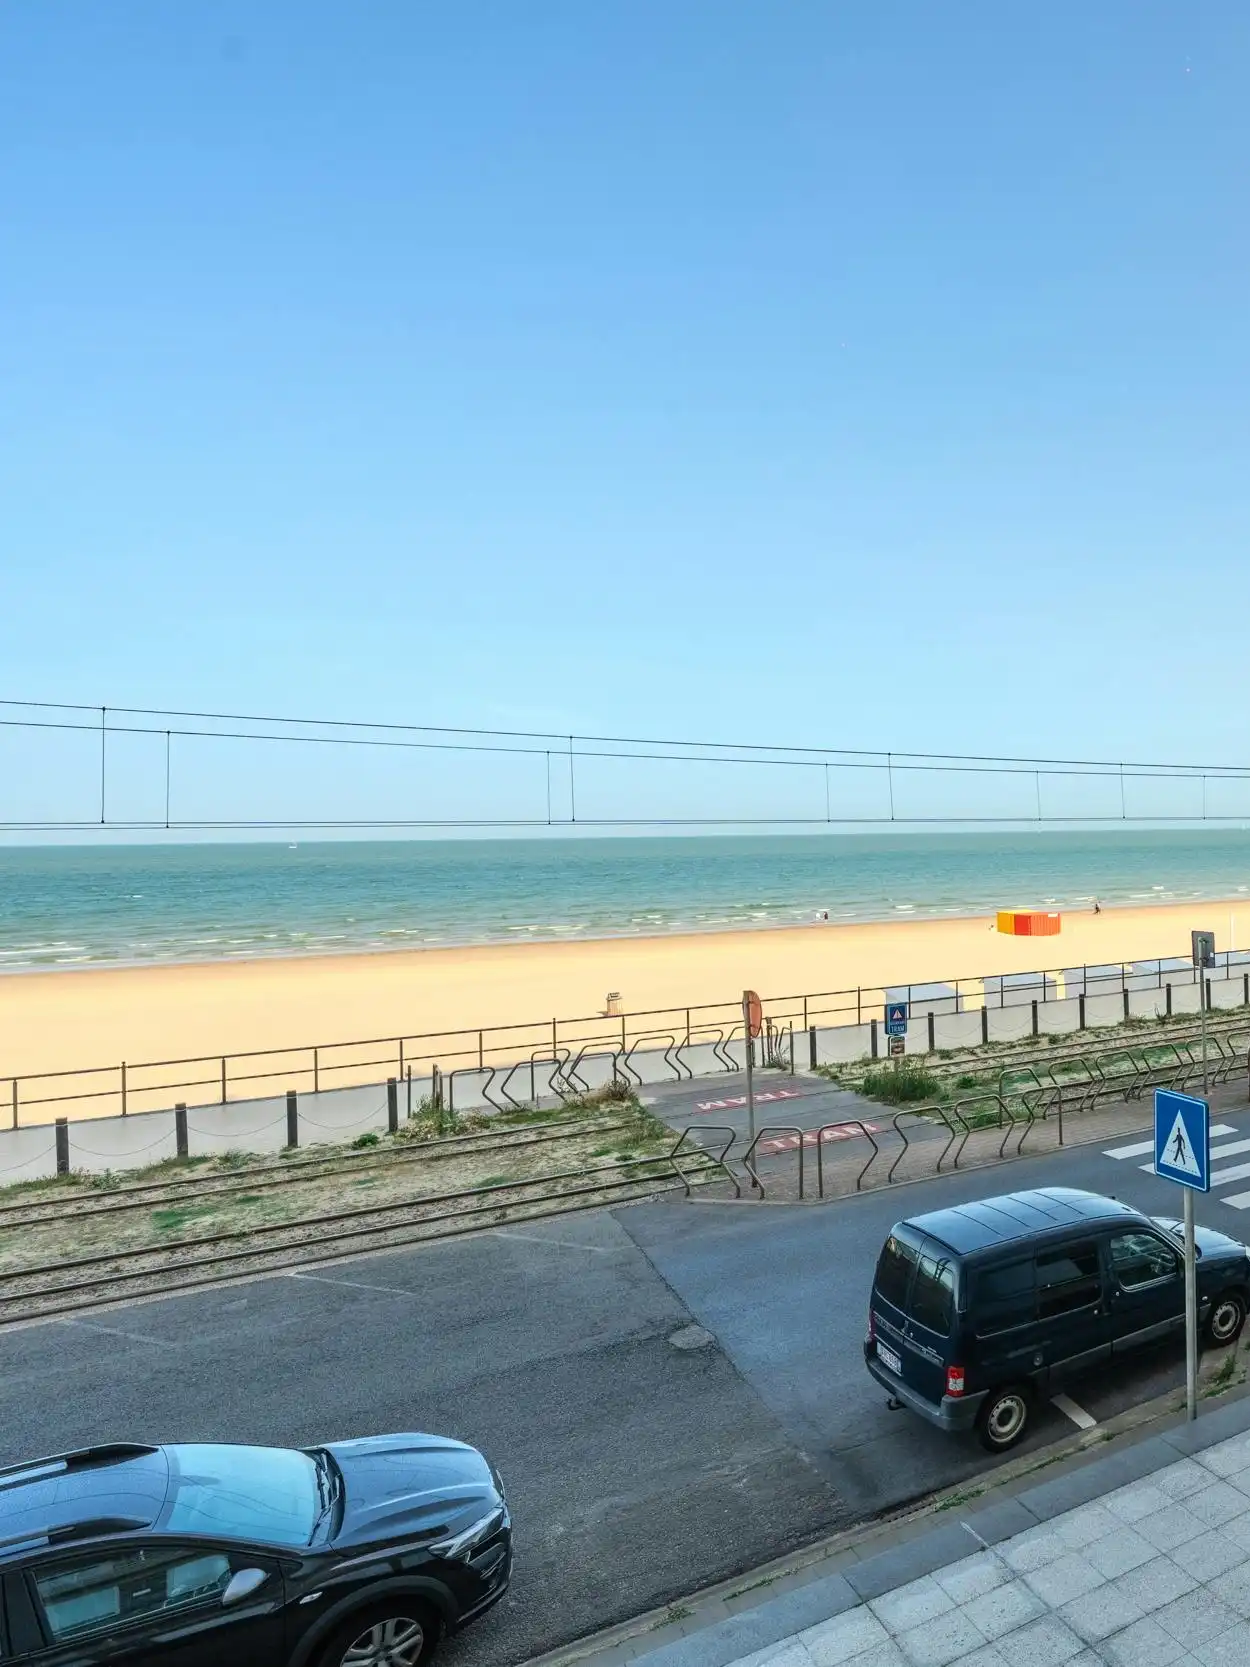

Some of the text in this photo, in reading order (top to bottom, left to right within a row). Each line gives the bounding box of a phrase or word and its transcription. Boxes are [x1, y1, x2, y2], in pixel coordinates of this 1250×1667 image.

[891, 1025, 905, 1033] TRAM
[698, 1091, 798, 1111] TRAM
[764, 1123, 877, 1148] TRAM
